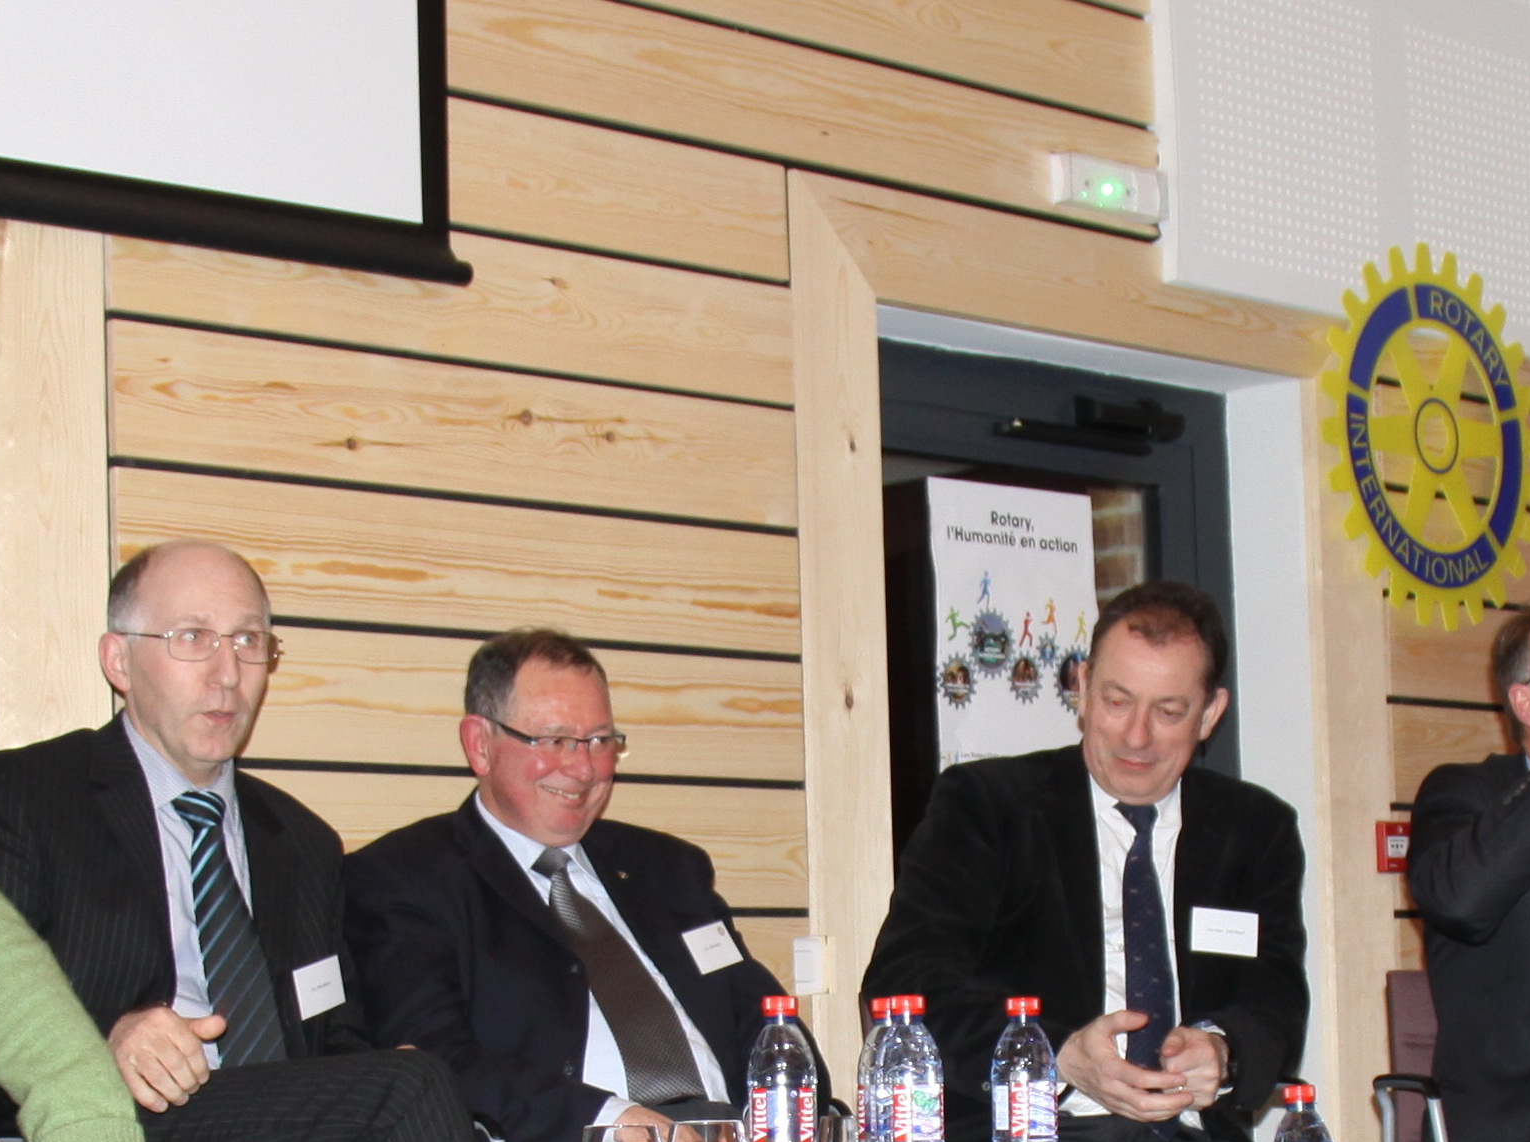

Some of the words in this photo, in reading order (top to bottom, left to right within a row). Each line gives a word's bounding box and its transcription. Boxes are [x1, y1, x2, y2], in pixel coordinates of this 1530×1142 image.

[1429, 289, 1511, 389] ROTARY
[990, 510, 1035, 533] Rotary,
[1349, 411, 1491, 584] INTERNATIONAL
[946, 525, 1017, 547] l'Humanité
[1020, 537, 1036, 549] en
[1039, 537, 1079, 553] action
[753, 1092, 768, 1142] Vittel
[799, 1092, 814, 1142] Vittel
